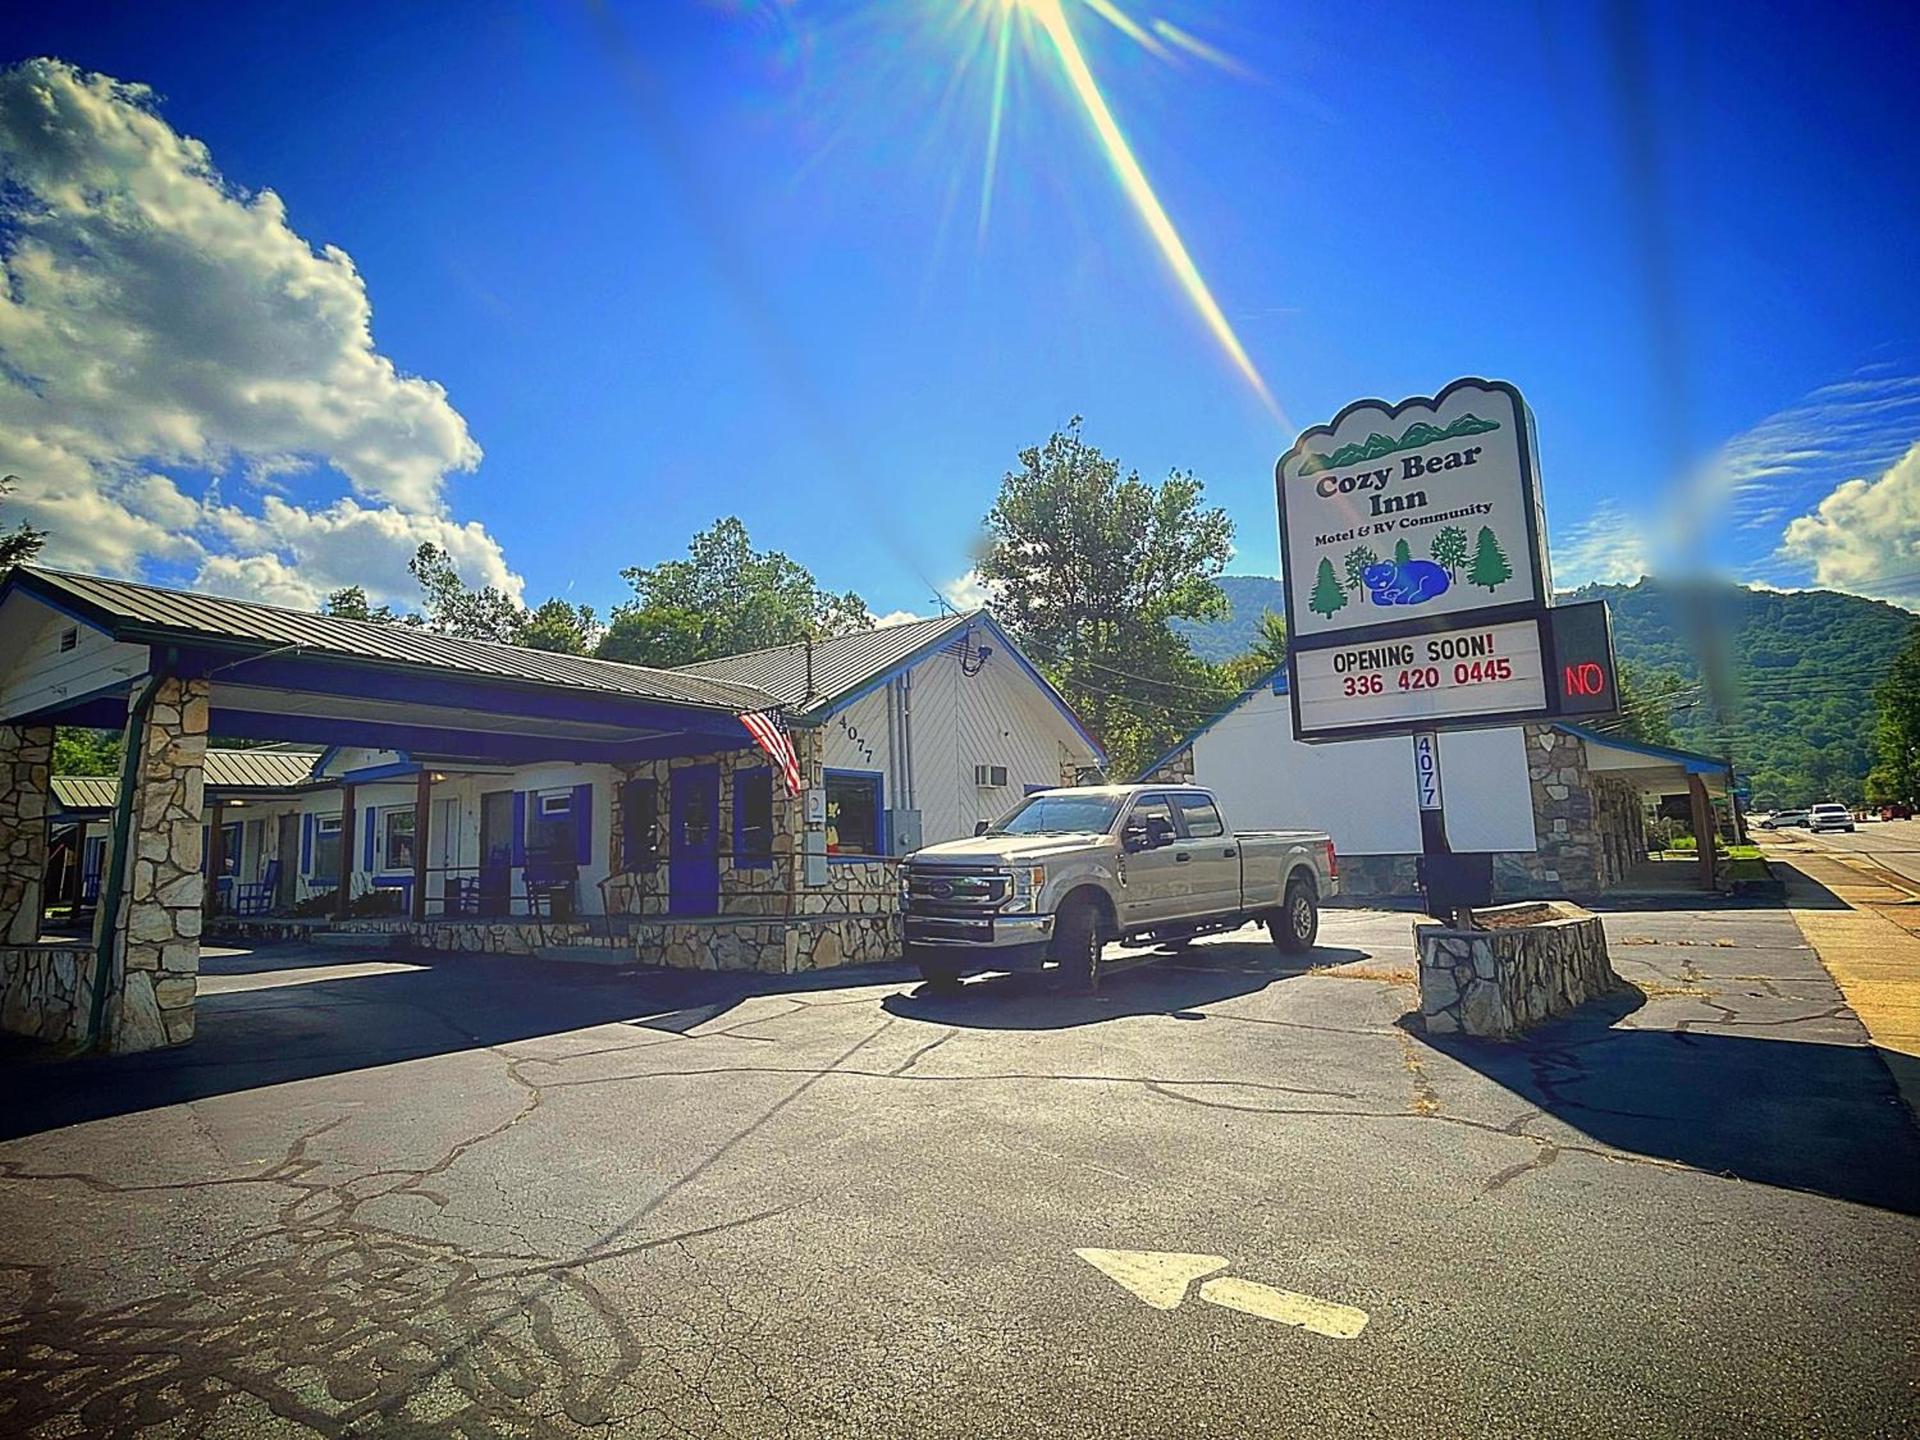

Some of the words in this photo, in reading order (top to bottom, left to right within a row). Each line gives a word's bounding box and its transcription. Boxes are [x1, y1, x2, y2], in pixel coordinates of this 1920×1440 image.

[1316, 468, 1393, 498] Cozy
[1400, 446, 1482, 480] Bear
[1314, 528, 1354, 546] Motel
[1357, 525, 1371, 537] &
[1374, 520, 1396, 535] RV
[1399, 502, 1493, 529] Community
[1369, 490, 1428, 516] Inn
[1333, 645, 1414, 673] OPENING
[1427, 633, 1494, 662] SOON!
[1343, 673, 1383, 697] 336
[1398, 667, 1440, 690] 420
[1454, 658, 1512, 685] 0445
[1566, 663, 1604, 696] NO
[839, 715, 873, 763] 4077
[1419, 737, 1435, 805] 4077
